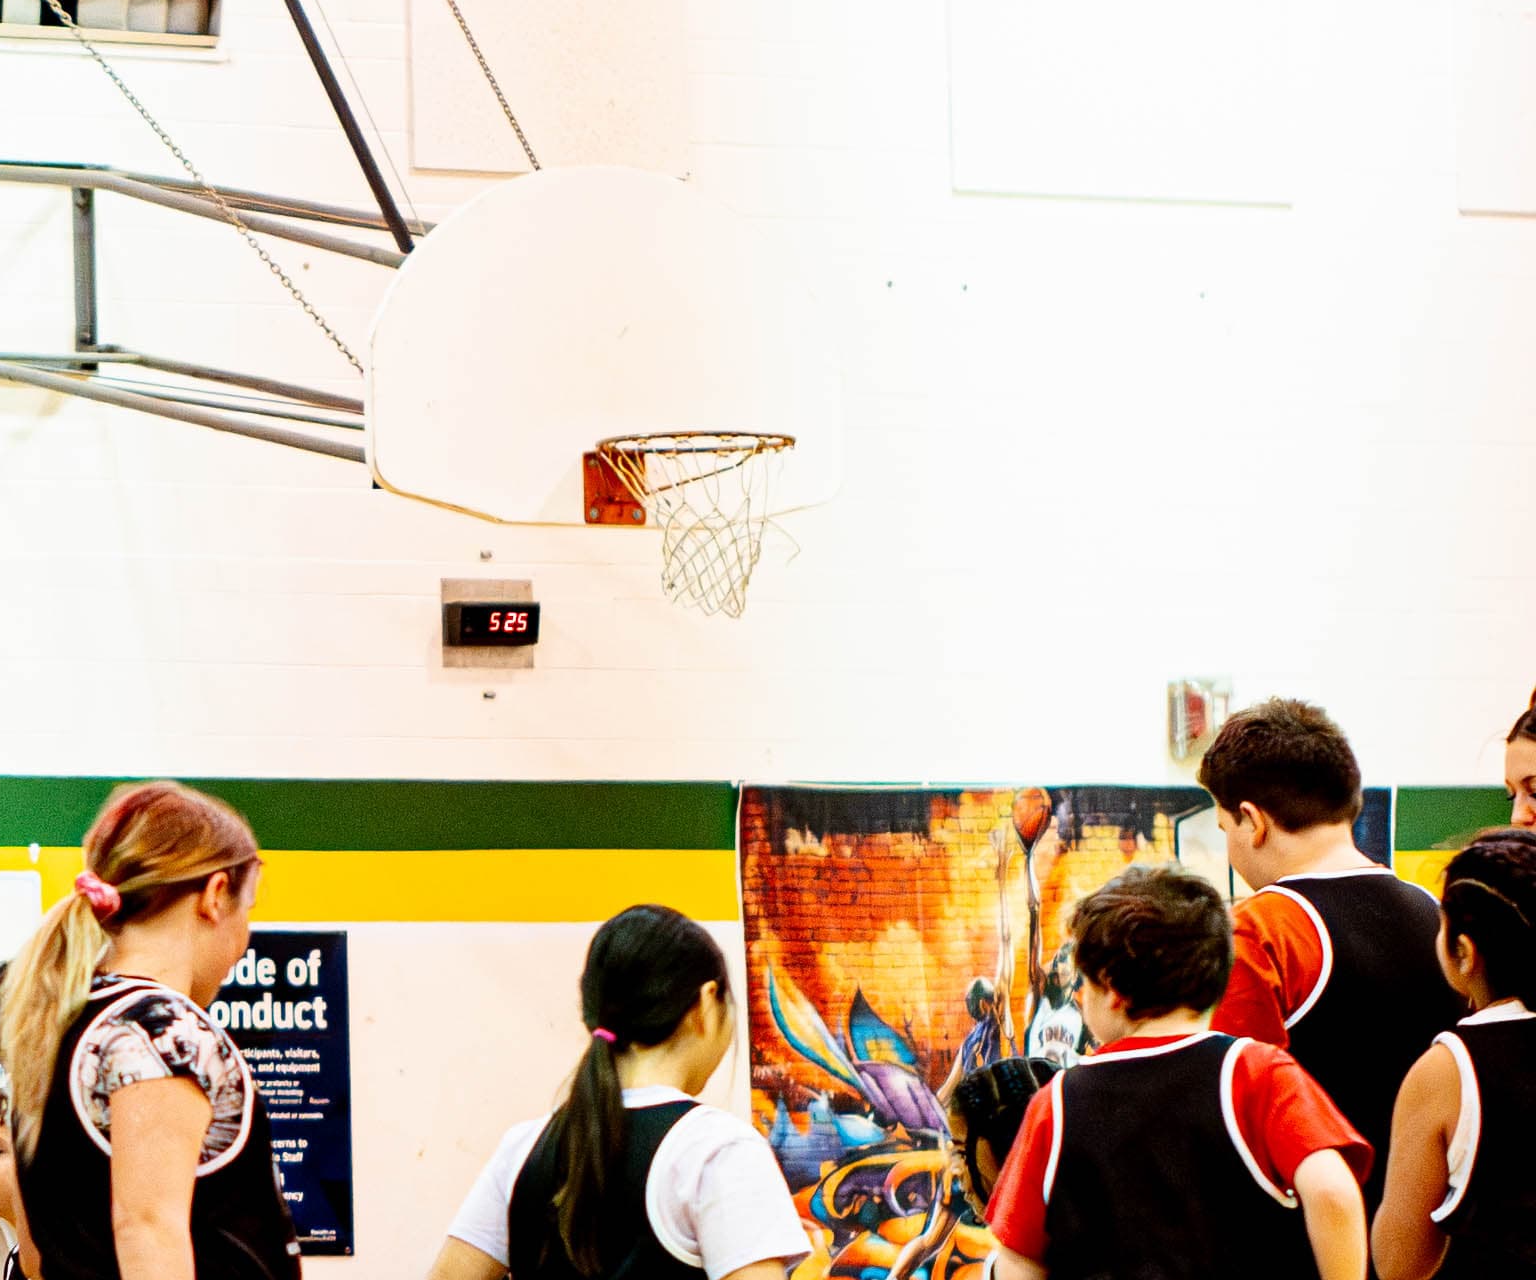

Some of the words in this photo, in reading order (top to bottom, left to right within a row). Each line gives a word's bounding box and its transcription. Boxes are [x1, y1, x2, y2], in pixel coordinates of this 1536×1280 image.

[220, 948, 276, 986] de
[286, 948, 321, 986] of
[209, 992, 328, 1030] onduct
[239, 1048, 284, 1060] rticipants,
